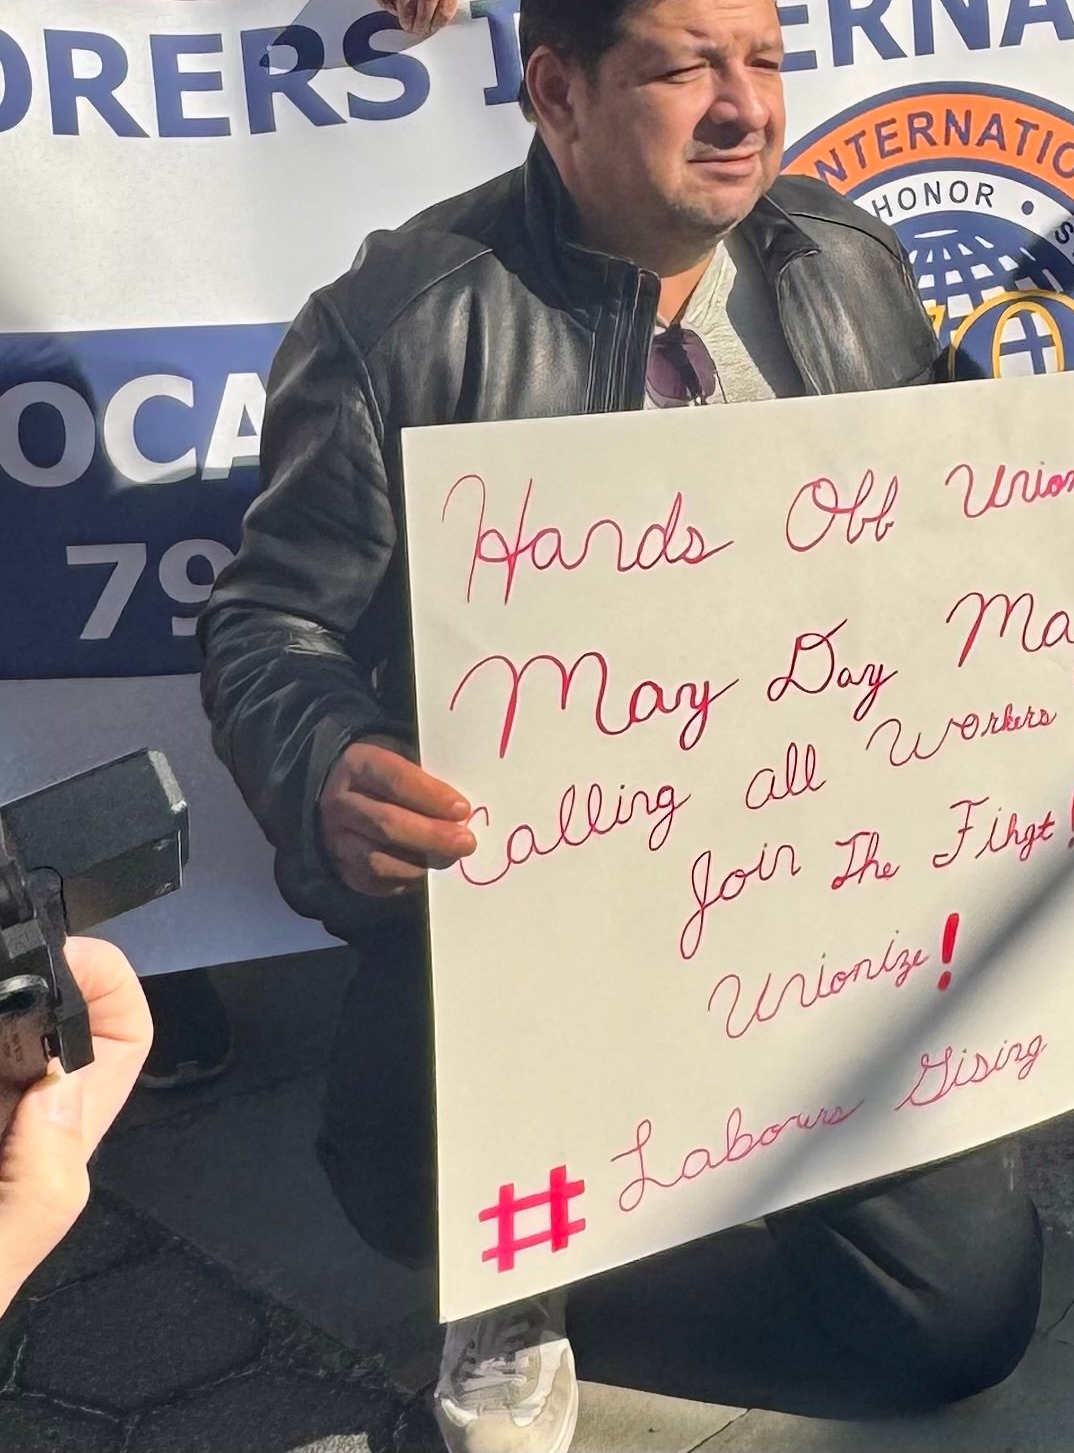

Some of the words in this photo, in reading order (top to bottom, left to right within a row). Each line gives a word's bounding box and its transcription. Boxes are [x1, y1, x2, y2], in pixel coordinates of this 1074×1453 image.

[872, 181, 996, 220] HONOR
[66, 538, 238, 640] 79
[441, 472, 735, 606] Hands
[448, 651, 740, 759] May
[766, 618, 899, 722] Day
[458, 783, 692, 886] Calling
[745, 742, 827, 809] all
[680, 843, 802, 960] Join
[830, 831, 901, 891] The
[707, 912, 961, 1039] Unionize!
[477, 1164, 587, 1274] #
